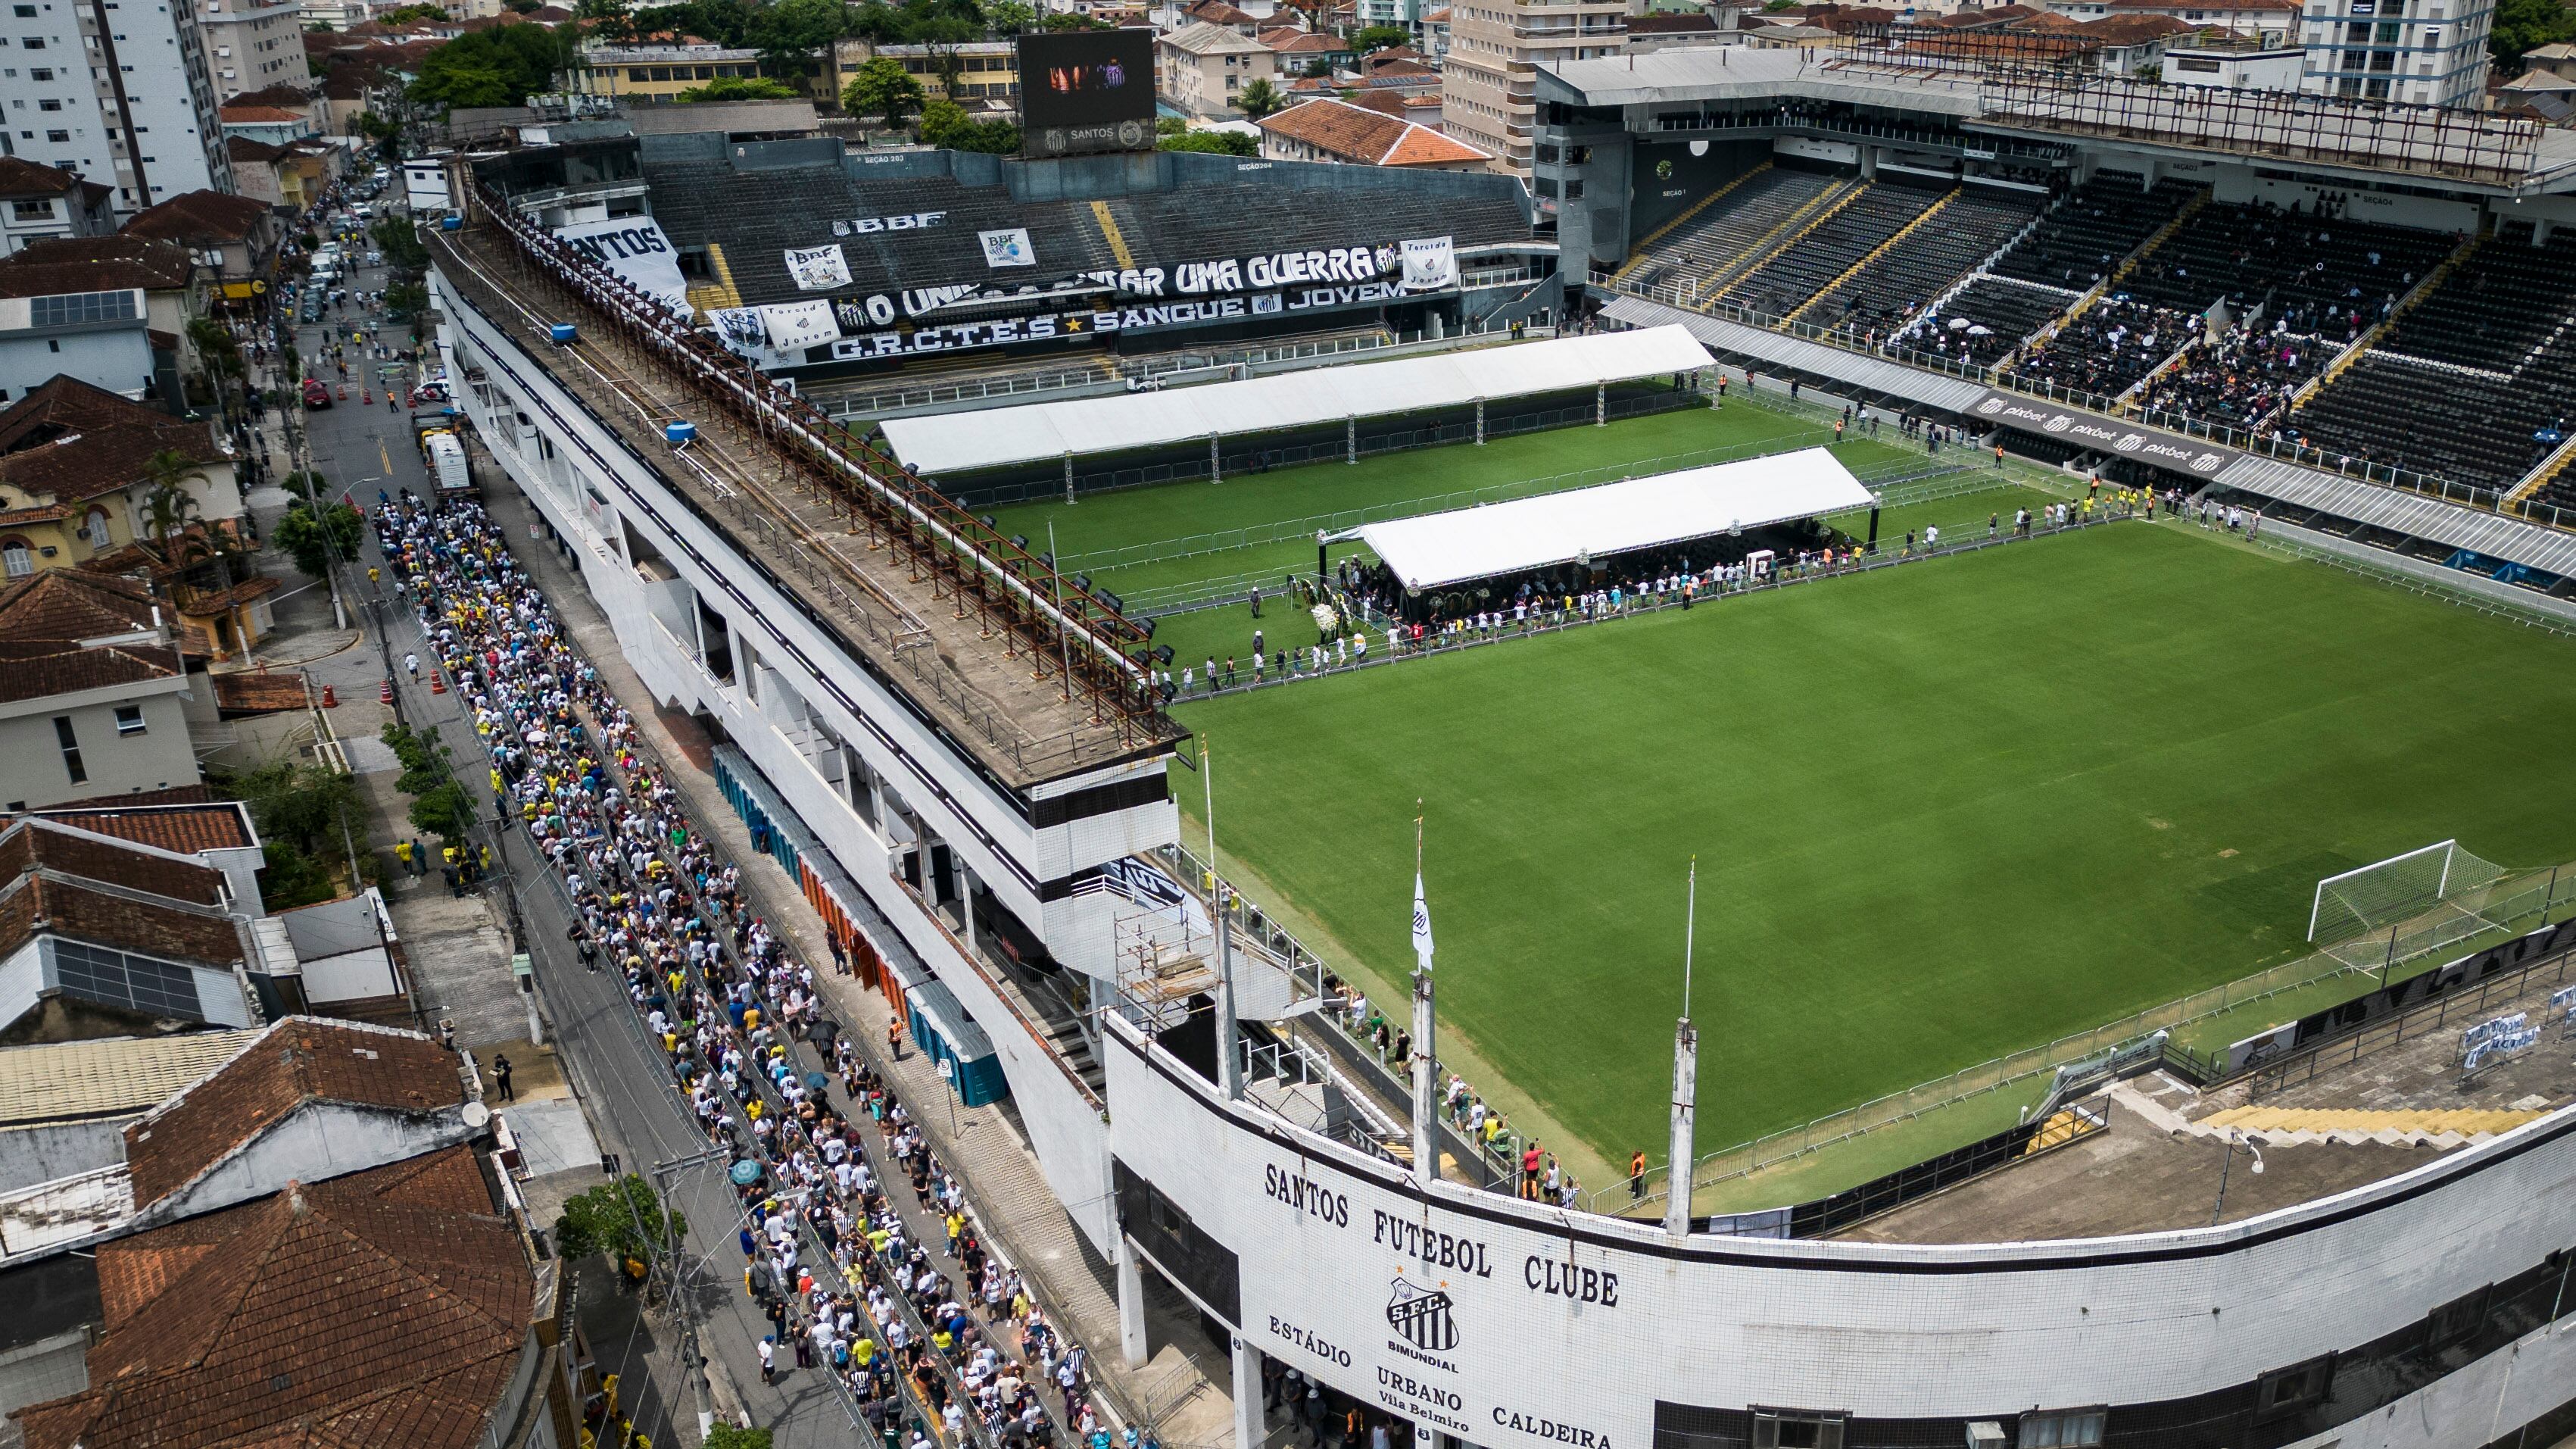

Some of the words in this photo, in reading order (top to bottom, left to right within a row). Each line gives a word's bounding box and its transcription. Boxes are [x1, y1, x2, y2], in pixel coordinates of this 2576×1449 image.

[1071, 128, 1114, 139] SANTOS
[987, 233, 1016, 247] BBF
[792, 246, 833, 264] BBF
[866, 294, 895, 325] O
[1175, 258, 1240, 294] UMA
[1247, 247, 1376, 288] GUERRA
[1093, 298, 1246, 332] SANGUE
[782, 329, 832, 347] Jovem
[2002, 406, 2047, 422] pixbet
[2069, 424, 2117, 441] pixbet
[2142, 444, 2194, 461] pixbet
[1265, 1163, 1349, 1229] SANTOS
[1374, 1210, 1492, 1279] FUTEBOL
[1524, 1254, 1619, 1308] CLUBE
[1392, 1295, 1445, 1321] S.F.C.
[1388, 1340, 1459, 1374] BIMUNDIAL
[881, 1372, 890, 1382] 10
[1269, 1314, 1352, 1368] ESTÁDIO
[1377, 1366, 1463, 1412] URBANO
[1492, 1407, 1611, 1449] CALDEIRA
[1379, 1391, 1405, 1411] Vila
[1409, 1402, 1470, 1433] Belmiro
